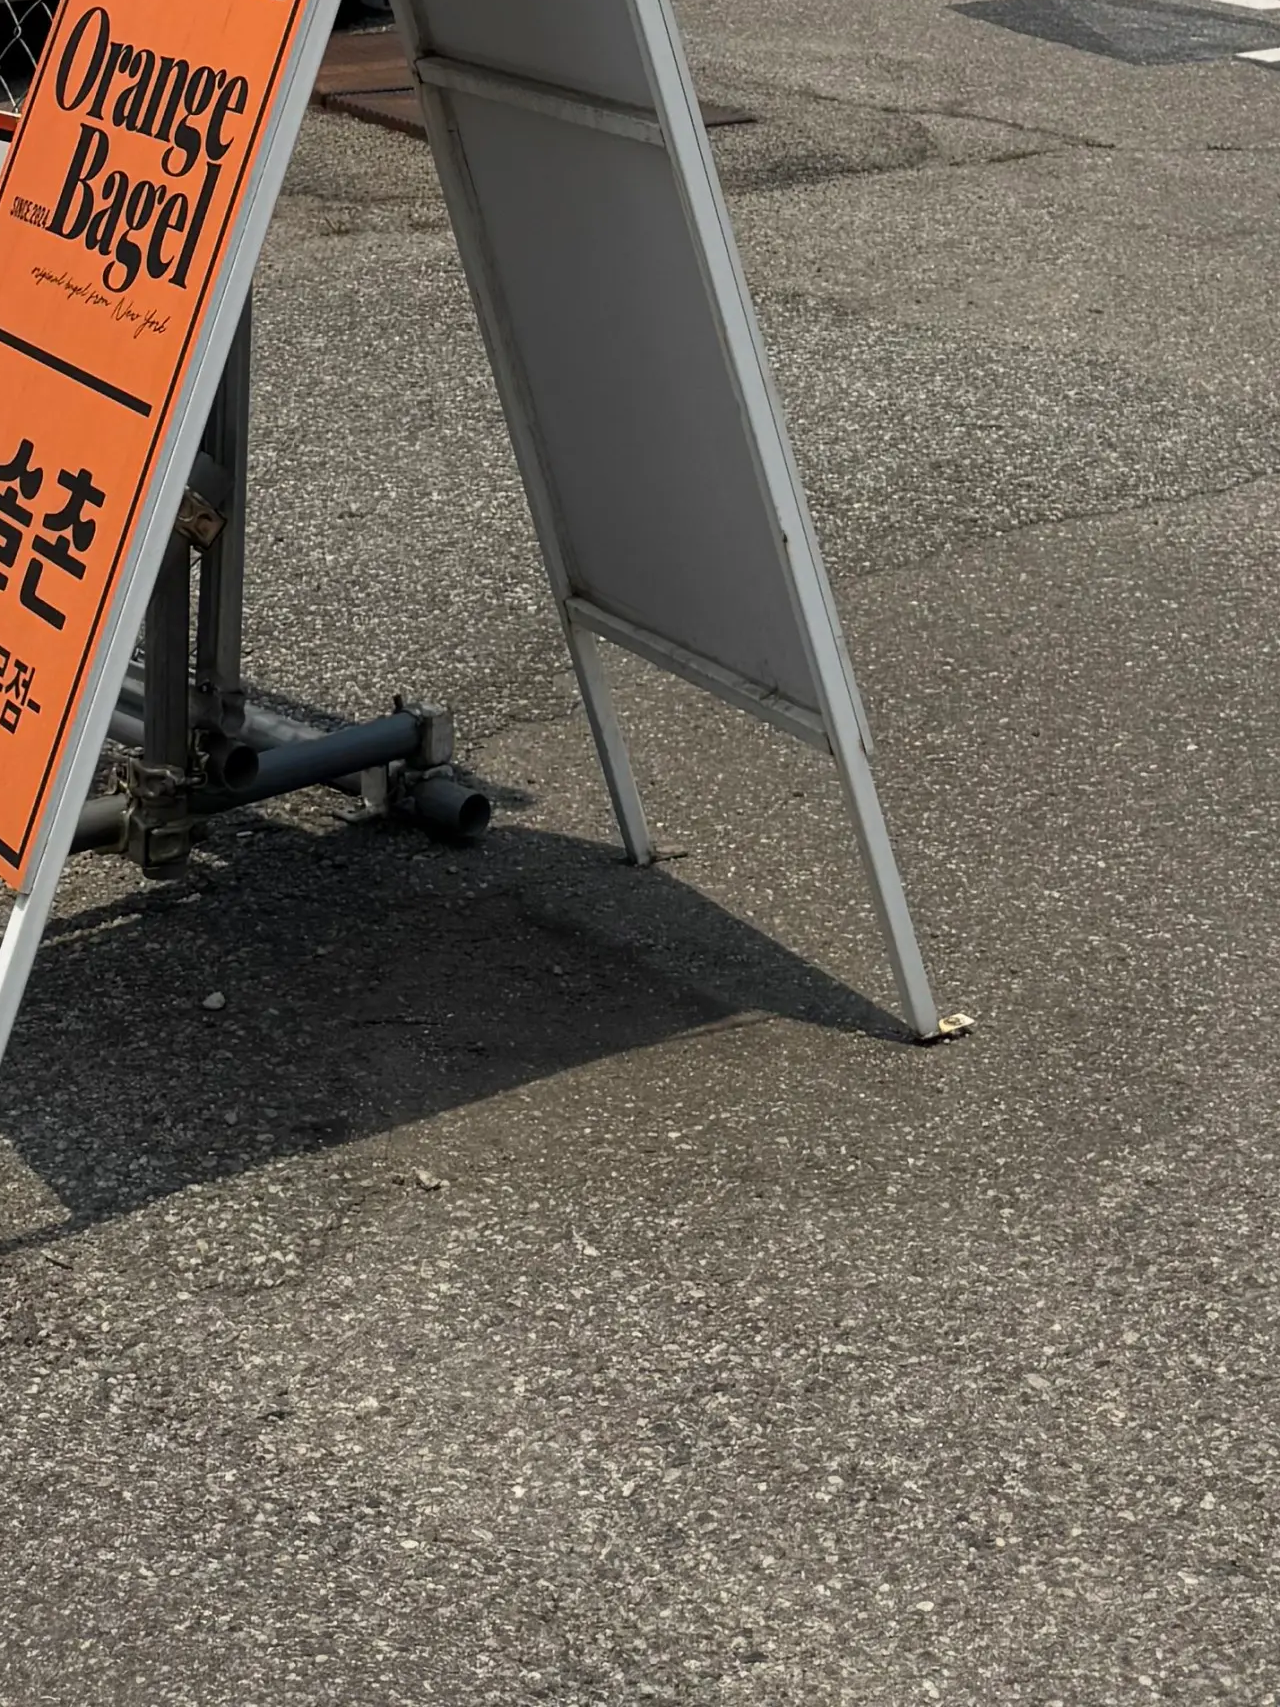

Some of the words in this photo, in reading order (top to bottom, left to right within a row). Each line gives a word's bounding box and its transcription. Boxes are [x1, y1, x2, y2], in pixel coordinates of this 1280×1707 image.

[55, 6, 249, 177] Orange
[10, 195, 33, 222] SINCE
[48, 122, 223, 293] Bagel
[111, 295, 141, 322] New
[133, 308, 172, 340] York
